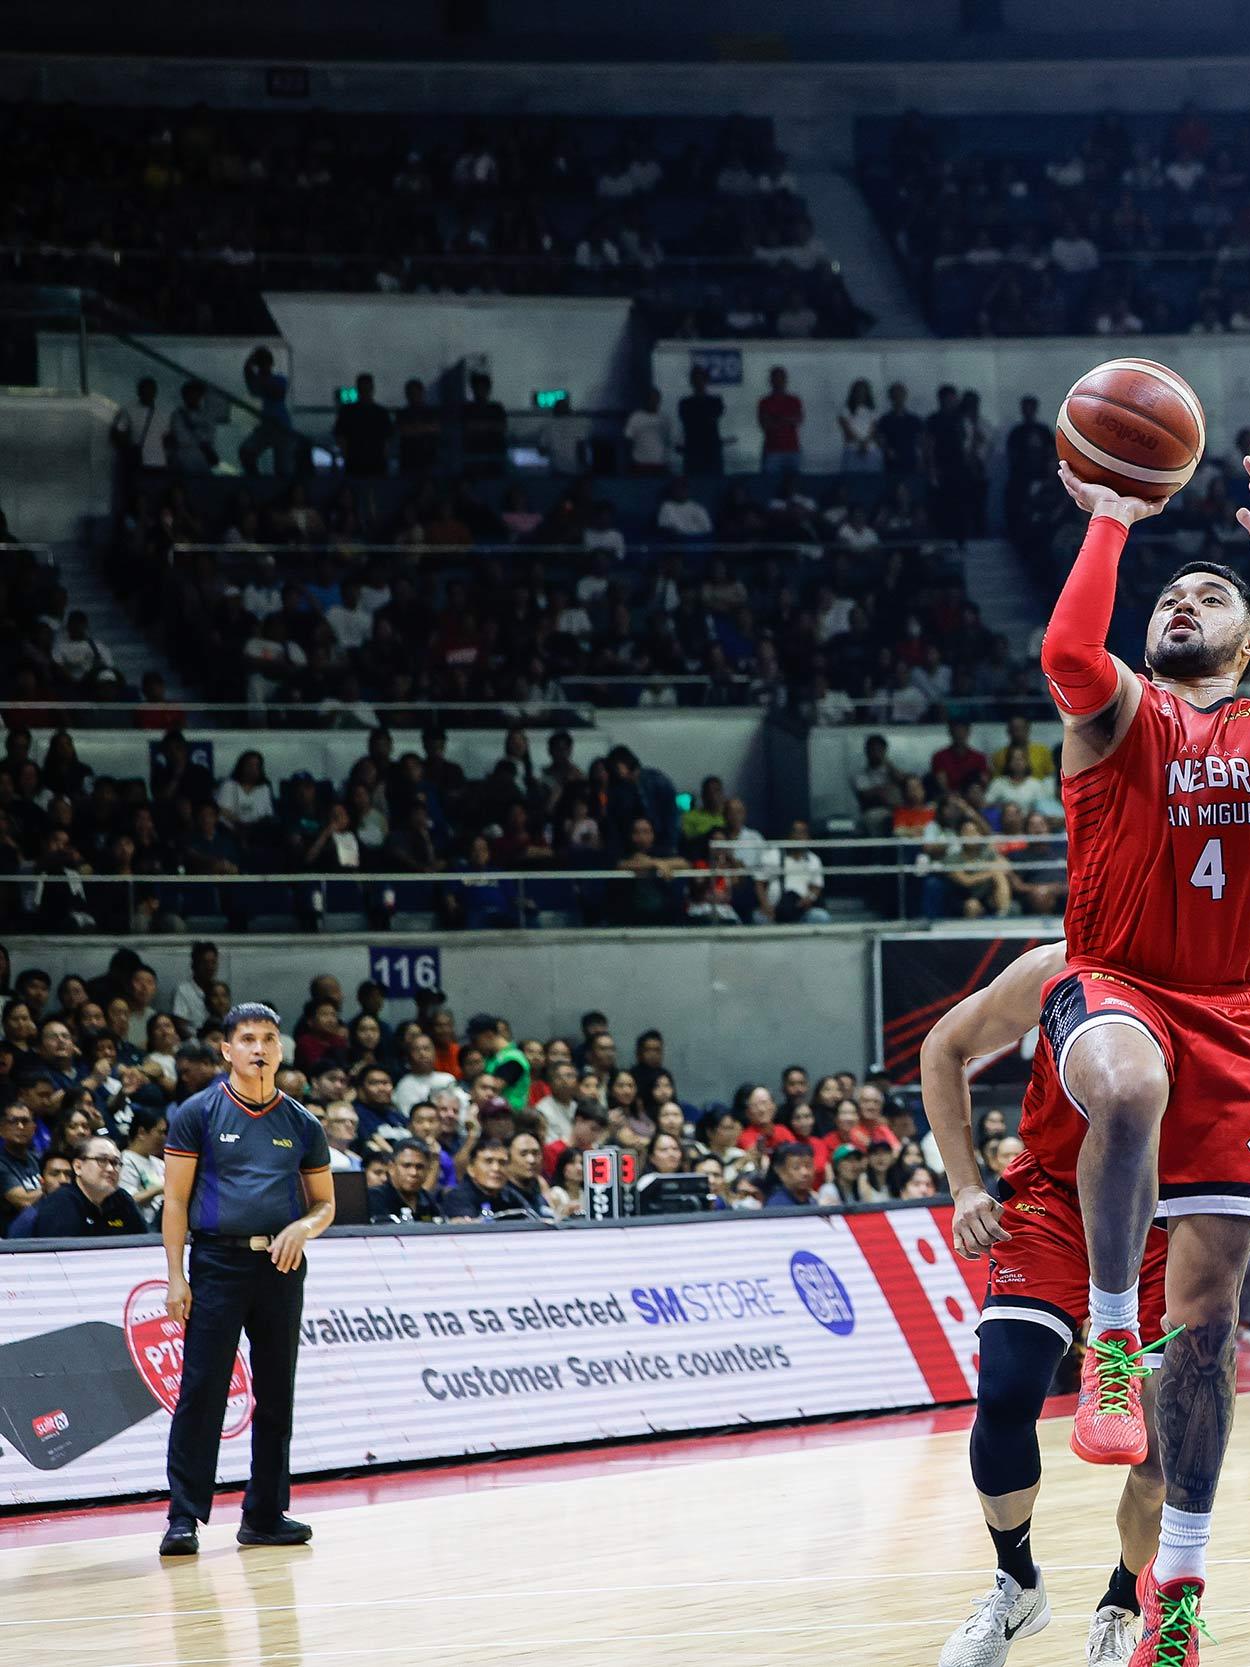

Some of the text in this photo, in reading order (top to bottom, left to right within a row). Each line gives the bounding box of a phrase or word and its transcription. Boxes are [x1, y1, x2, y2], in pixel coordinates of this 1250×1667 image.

[1190, 838, 1226, 900] 4
[374, 964, 438, 992] 116
[300, 1306, 421, 1346] vailable
[425, 1309, 465, 1337] na
[469, 1308, 505, 1334] sa
[508, 1292, 628, 1331] selected
[422, 1342, 792, 1400] Customer Service counters
